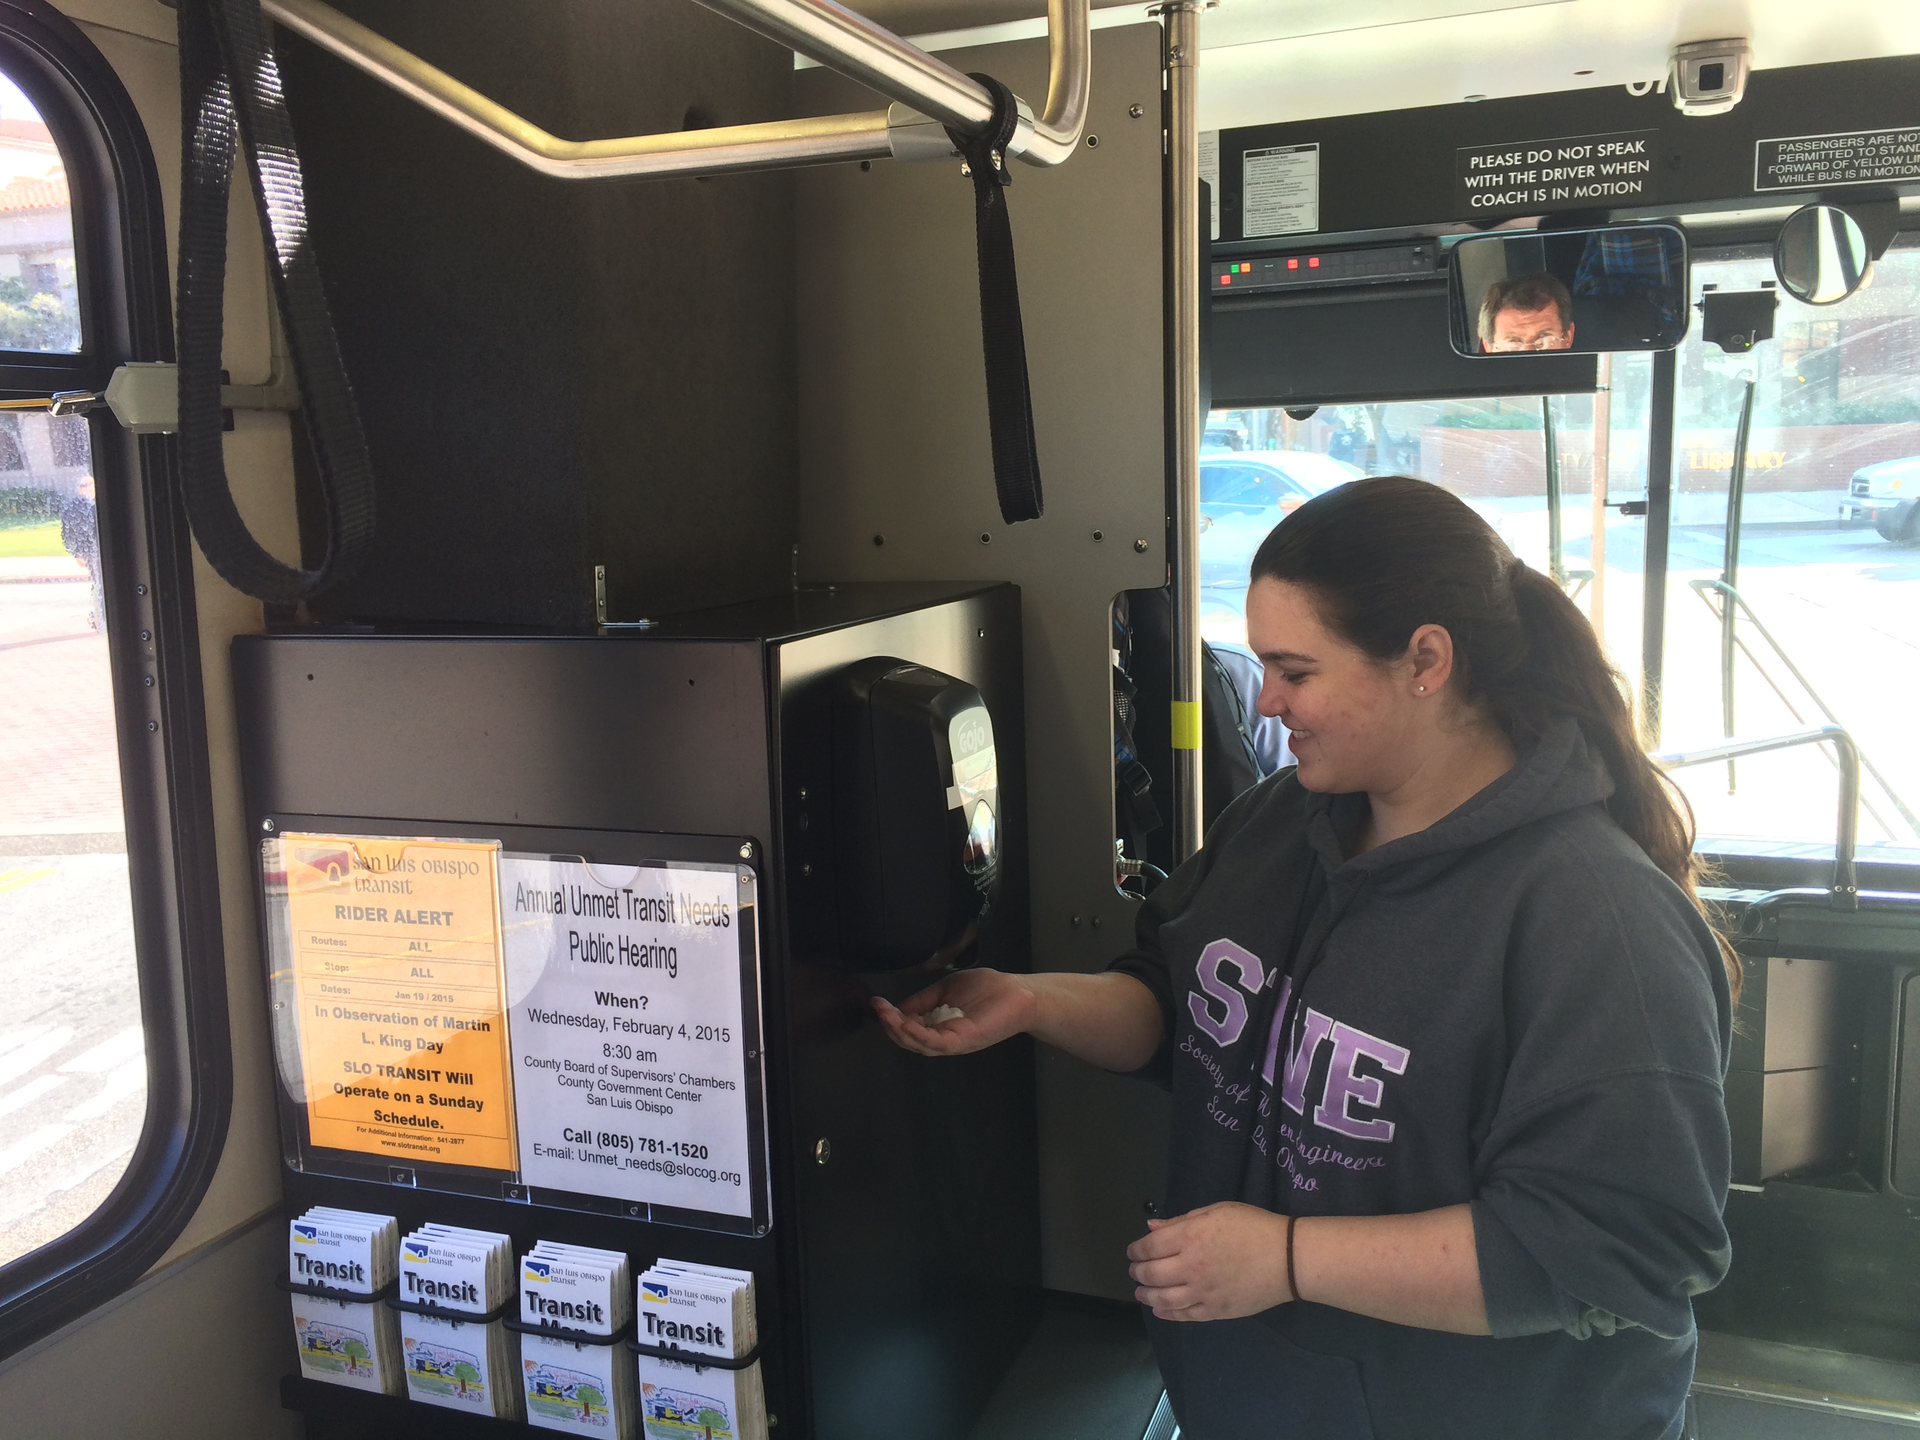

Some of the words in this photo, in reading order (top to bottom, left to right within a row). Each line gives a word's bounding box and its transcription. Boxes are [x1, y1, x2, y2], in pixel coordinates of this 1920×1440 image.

[1470, 152, 1522, 169] PLEASE
[1527, 149, 1553, 164] DO
[1557, 145, 1593, 161] NOT
[1597, 140, 1645, 157] SPEAK
[1778, 137, 1865, 153] PASSENGERS
[1868, 134, 1895, 145] ARE
[1778, 149, 1854, 163] PERMITTED
[1857, 146, 1876, 157] TO
[1464, 173, 1503, 189] WITH
[1508, 170, 1537, 185] THE
[1542, 164, 1596, 182] DRIVER
[1600, 159, 1650, 176] WHEN
[1768, 160, 1830, 174] FORWARD
[1832, 159, 1850, 169] OF
[1853, 155, 1904, 167] YELLOW
[1778, 172, 1815, 184] WHILE
[1818, 170, 1842, 181] BUS
[1845, 169, 1857, 179] IS
[1860, 168, 1872, 177] IN
[1874, 164, 1920, 176] MOTION
[1471, 190, 1528, 207] COACH
[1533, 188, 1547, 202] IS
[1552, 186, 1569, 200] IN
[1574, 180, 1642, 198] MOTION
[335, 905, 389, 923] RIDER
[394, 909, 453, 927] ALERT
[515, 881, 566, 915] Annual
[571, 884, 620, 920] Unmet
[623, 888, 676, 924] Transit
[680, 895, 730, 928] Needs
[311, 935, 347, 947] Routes:
[408, 941, 433, 953] ALL
[569, 930, 615, 965] Public
[618, 935, 677, 979] Hearing
[324, 961, 349, 974] Stop:
[410, 966, 434, 979] ALL
[320, 983, 351, 995] Dates:
[394, 990, 411, 1000] Jan
[412, 991, 425, 1001] 19
[432, 993, 454, 1003] 2015
[594, 990, 649, 1010] When?
[315, 1005, 328, 1018] In
[333, 1006, 419, 1027] Observation
[423, 1014, 439, 1028] of
[442, 1015, 491, 1033] Martin
[527, 1007, 609, 1033] Wednesday,
[612, 1016, 674, 1040] February
[677, 1023, 691, 1040] 4,
[695, 1024, 731, 1043] 2015
[361, 1032, 375, 1046] L.
[379, 1034, 412, 1051] King
[416, 1039, 444, 1054] Day
[602, 1043, 632, 1060] 8:30
[636, 1049, 658, 1063] am
[343, 1059, 372, 1075] SLO
[376, 1063, 441, 1083] TRANSIT
[446, 1070, 474, 1086] Will
[523, 1055, 561, 1073] County
[564, 1059, 595, 1075] Board
[597, 1063, 608, 1076] of
[679, 1073, 736, 1091] Chambers
[1179, 1034, 1224, 1089] Society
[1225, 1083, 1251, 1105] of
[333, 1082, 389, 1101] Operate
[393, 1091, 411, 1102] on
[416, 1094, 424, 1105] a
[429, 1093, 484, 1112] Sunday
[557, 1074, 594, 1091] County
[597, 1078, 663, 1099] Government
[665, 1087, 702, 1103] Center
[586, 1093, 608, 1107] San
[610, 1095, 632, 1110] Luis
[635, 1099, 674, 1116] Obispo
[1207, 1095, 1240, 1131] San
[356, 1125, 367, 1133] For
[368, 1127, 397, 1139] Additional
[374, 1109, 444, 1130] Schedule.
[381, 1139, 441, 1154] www.slotransit.org
[563, 1127, 592, 1145] Call
[596, 1131, 634, 1153] (805)
[638, 1137, 708, 1160] 781-1520
[533, 1143, 574, 1161] E-mail:
[578, 1148, 741, 1187] Unmet_needs@slocog.org
[294, 1252, 363, 1282] Transit
[404, 1270, 477, 1302] Transit
[525, 1290, 602, 1323] Transit
[643, 1311, 723, 1345] Transit
